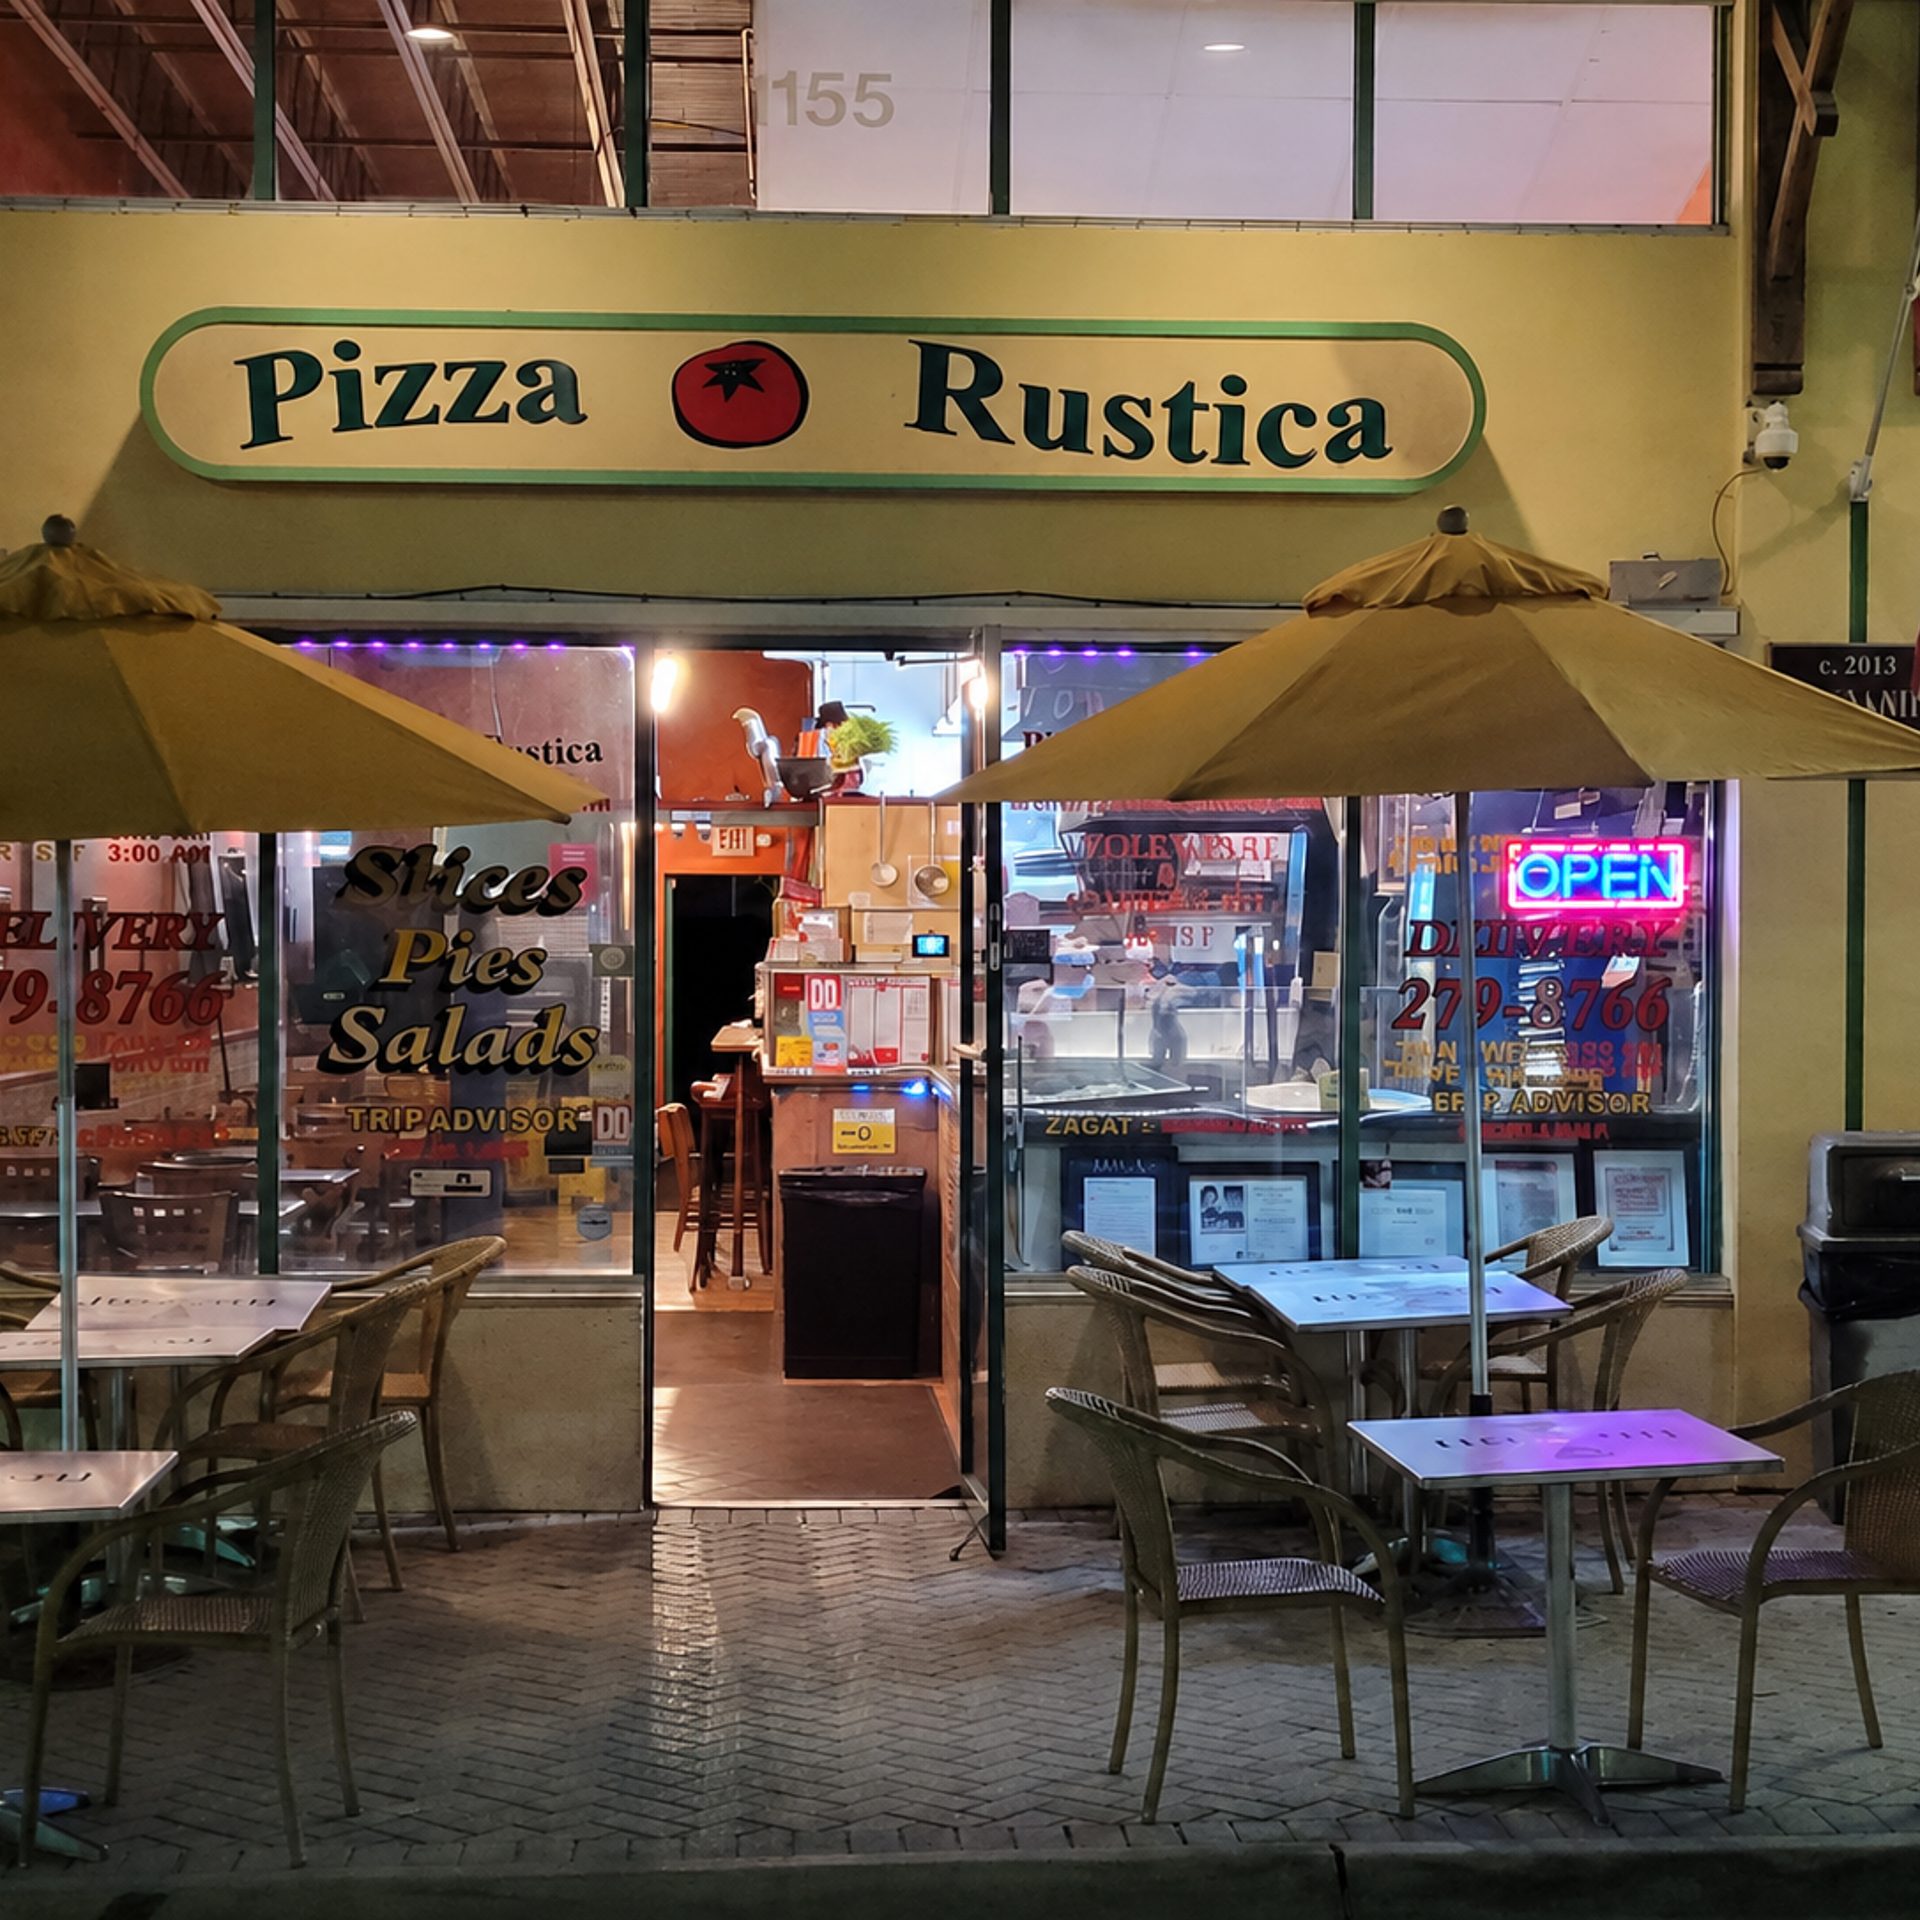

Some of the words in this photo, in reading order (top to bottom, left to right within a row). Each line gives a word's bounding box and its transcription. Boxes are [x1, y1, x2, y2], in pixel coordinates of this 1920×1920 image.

[233, 339, 588, 450] Pizza
[904, 339, 1394, 469] Rustica
[1819, 662, 1838, 676] c.
[1844, 655, 1897, 676] 2013
[108, 843, 160, 863] 3:00
[1517, 853, 1678, 899] OPEN
[338, 844, 588, 915] Slices
[0, 911, 224, 950] ELVERY
[377, 927, 549, 994] Pies
[1391, 976, 1673, 1030] 279-8766
[317, 1003, 601, 1076] Salads
[1512, 1090, 1650, 1114] ADVISOR
[1045, 1117, 1132, 1135] ZAGAT
